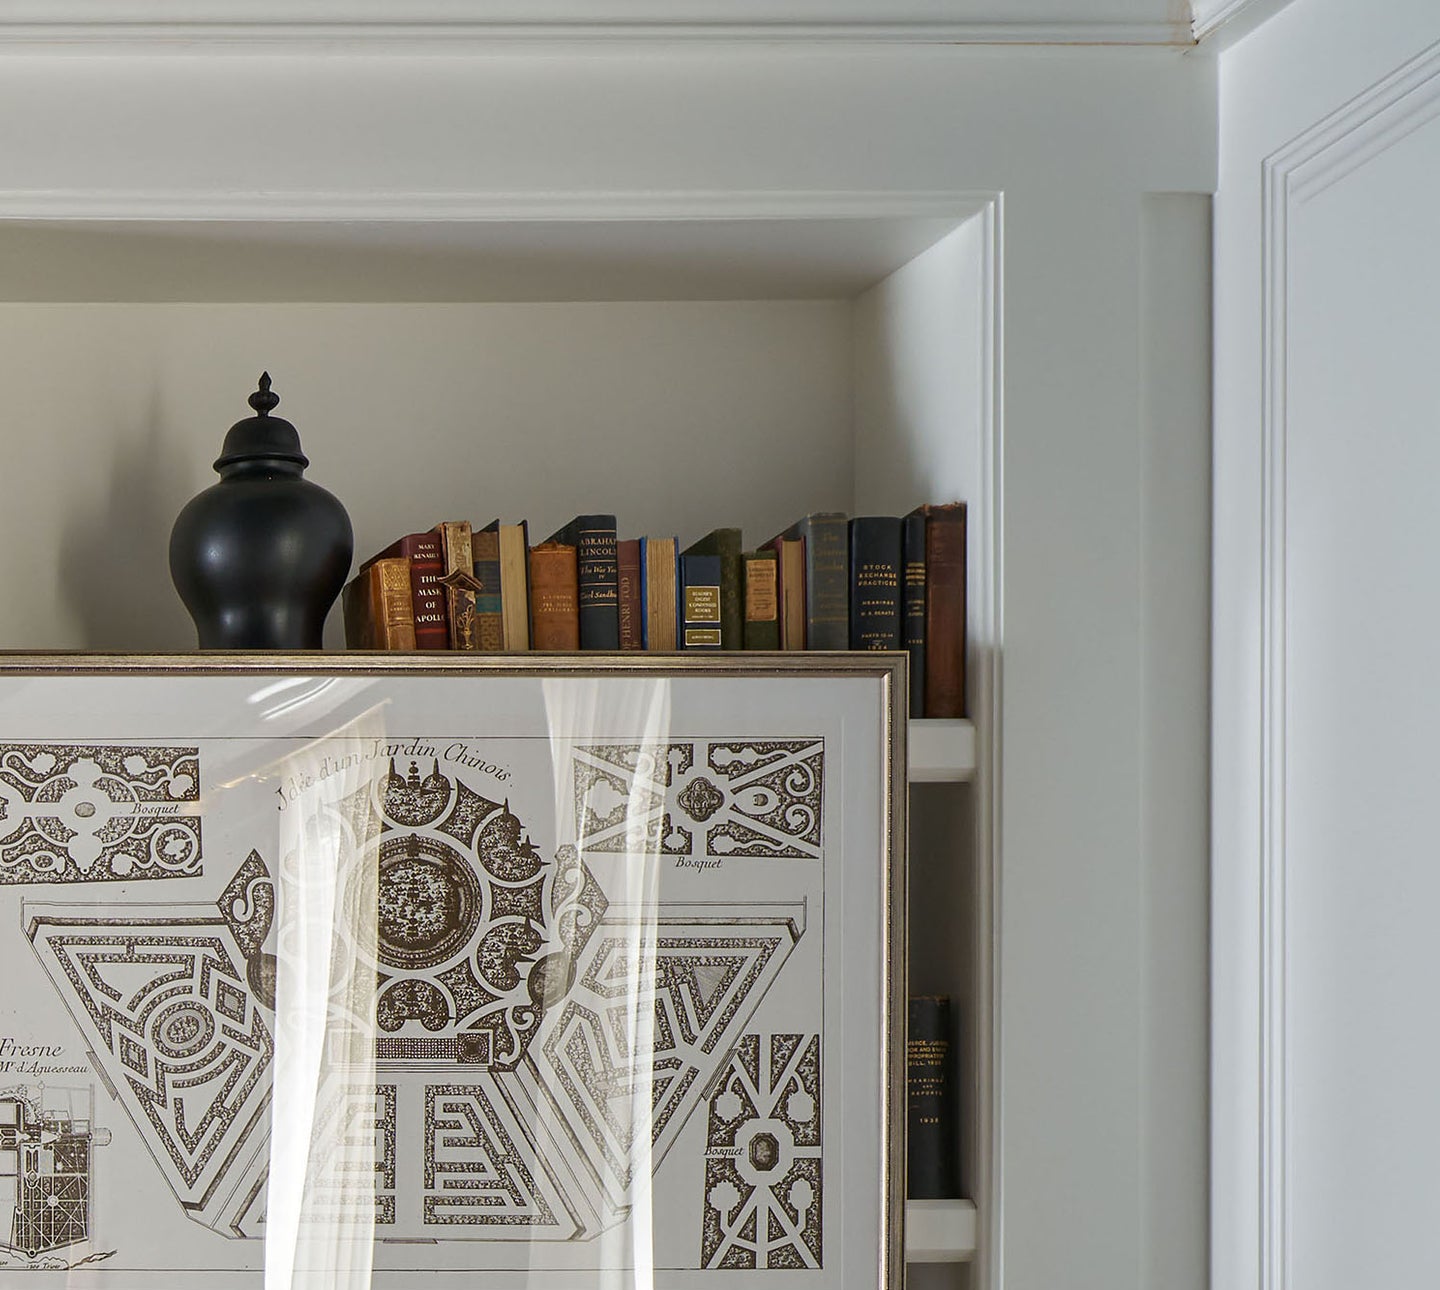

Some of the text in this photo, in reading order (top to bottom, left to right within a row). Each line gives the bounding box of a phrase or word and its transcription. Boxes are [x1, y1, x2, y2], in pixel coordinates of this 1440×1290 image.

[365, 737, 440, 761] Jardin
[129, 801, 181, 817] Bosquet
[674, 855, 723, 872] Bosquet
[704, 1144, 745, 1160] Bosquet
